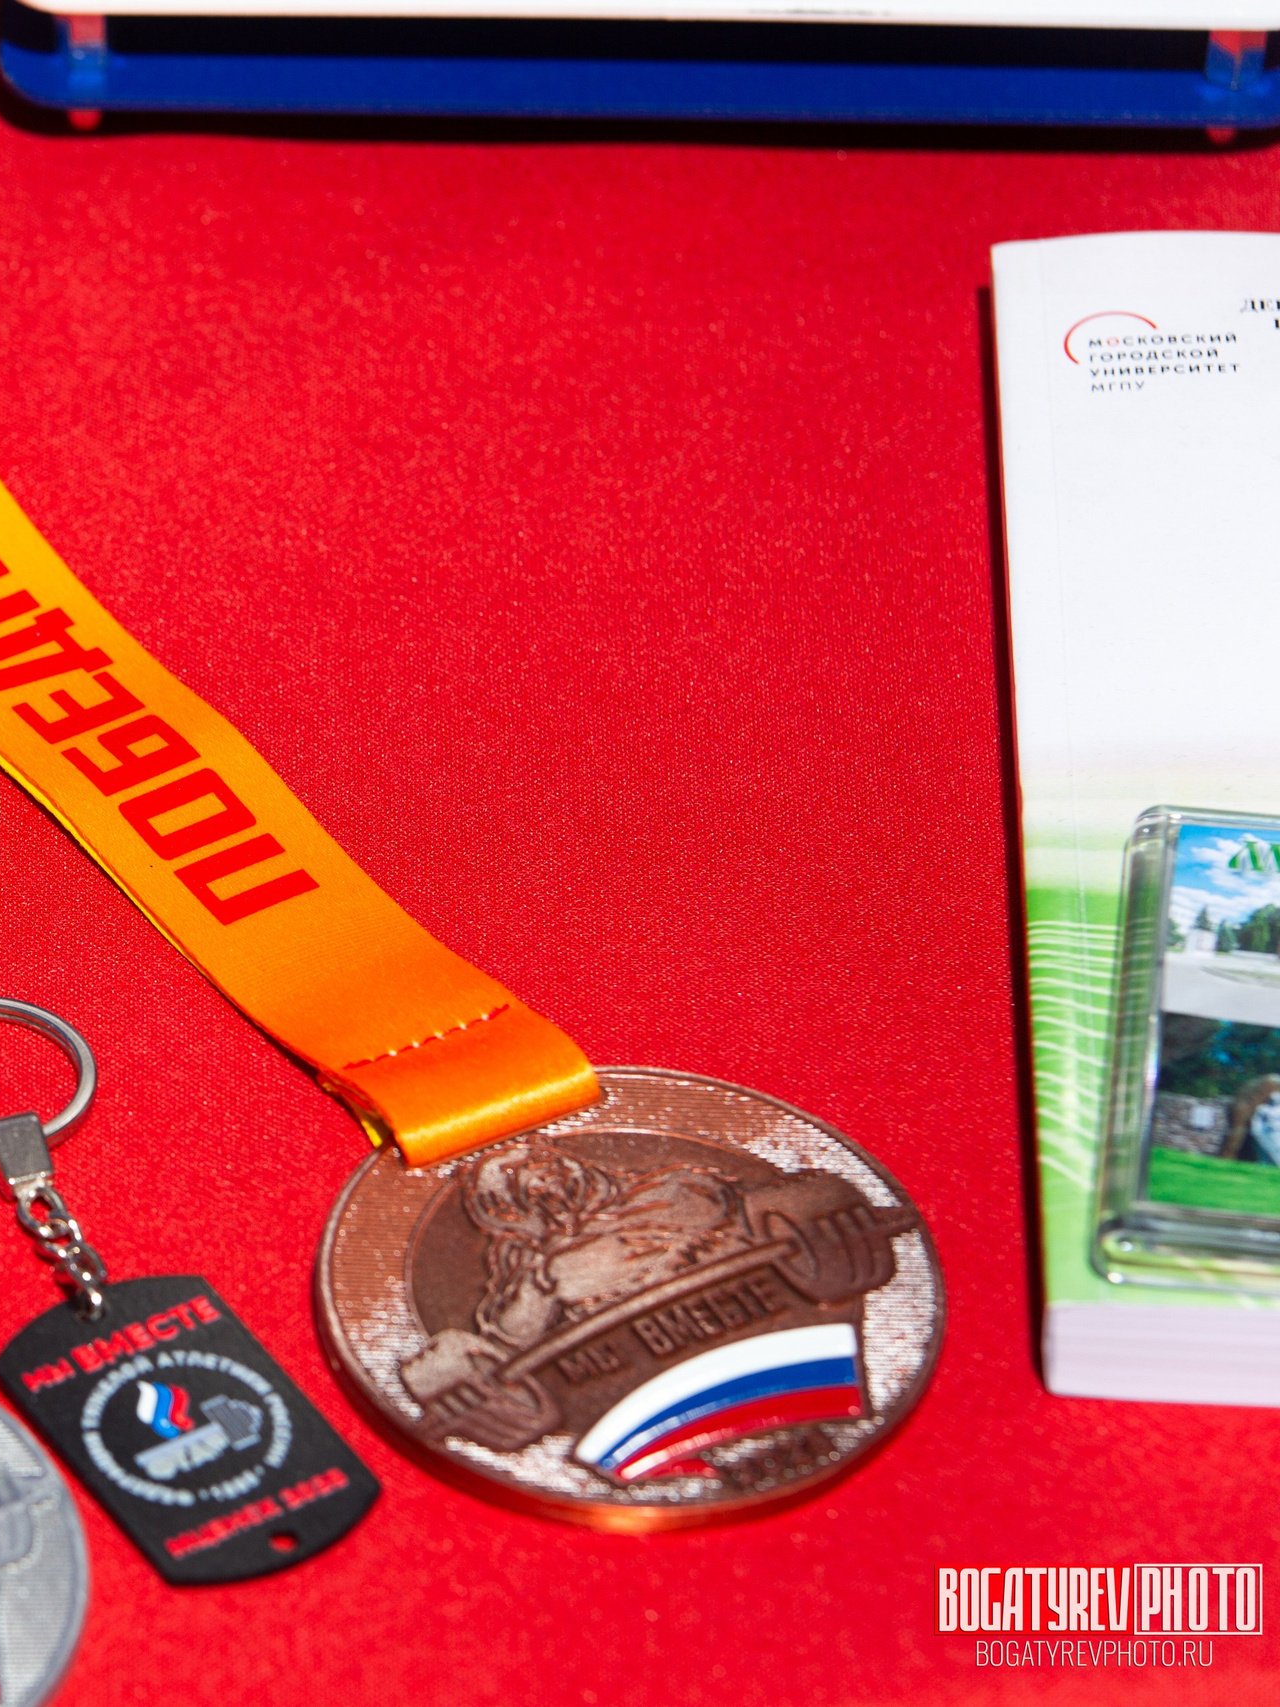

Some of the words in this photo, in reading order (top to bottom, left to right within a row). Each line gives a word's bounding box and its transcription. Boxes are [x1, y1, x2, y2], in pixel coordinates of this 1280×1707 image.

[1088, 332, 1238, 348] МОСКОВСКИЙ
[1089, 347, 1220, 362] ГОРОДСКОЙ
[1090, 362, 1241, 377] УНИВЕРСИТЕТ
[1091, 380, 1146, 393] МГПУ
[70, 1295, 221, 1374] ВМЕСТЕ
